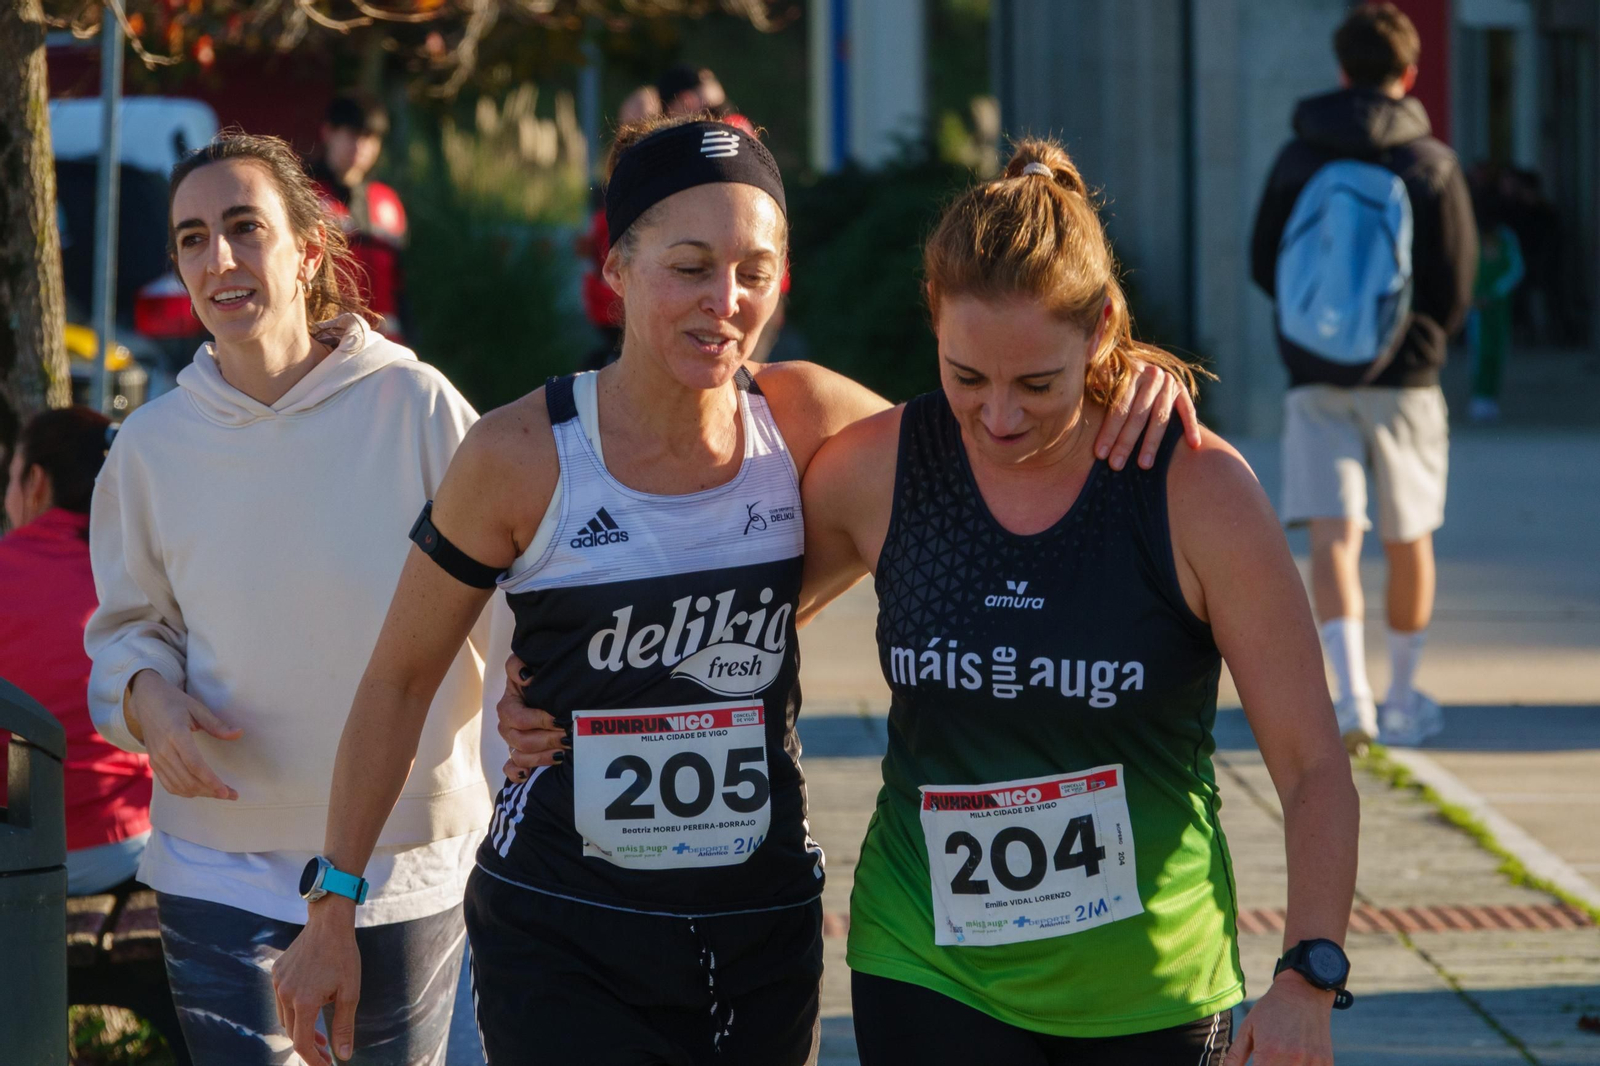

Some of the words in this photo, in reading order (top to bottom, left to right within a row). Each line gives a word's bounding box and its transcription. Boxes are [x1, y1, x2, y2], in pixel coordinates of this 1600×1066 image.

[570, 529, 629, 549] adidas
[984, 594, 1045, 609] amura
[708, 653, 762, 679] fresh
[890, 637, 983, 690] máis
[992, 646, 1024, 699] que
[1029, 656, 1145, 708] auga
[733, 711, 757, 719] CONCELLO
[641, 734, 665, 743] MILLA
[666, 732, 696, 741] CIDADE
[696, 731, 708, 739] DE
[709, 729, 728, 738] VIGO
[605, 746, 770, 820] 205
[1061, 781, 1086, 790] CONCELLO
[970, 811, 992, 819] MILLA
[993, 807, 1023, 816] CIDADE
[1024, 805, 1035, 813] DE
[1037, 801, 1057, 811] VIGO
[622, 826, 651, 834] Beatriz
[653, 825, 681, 833] MOREU
[683, 819, 757, 832] PEREIRA-BORRAJO
[687, 845, 729, 854] DEPORTE
[944, 813, 1107, 895] 204
[1118, 851, 1126, 866] 204
[985, 901, 1008, 909] Emilia
[1009, 897, 1034, 906] VIDAL
[1035, 890, 1072, 904] LORENZO
[1028, 914, 1070, 926] DEPORTE
